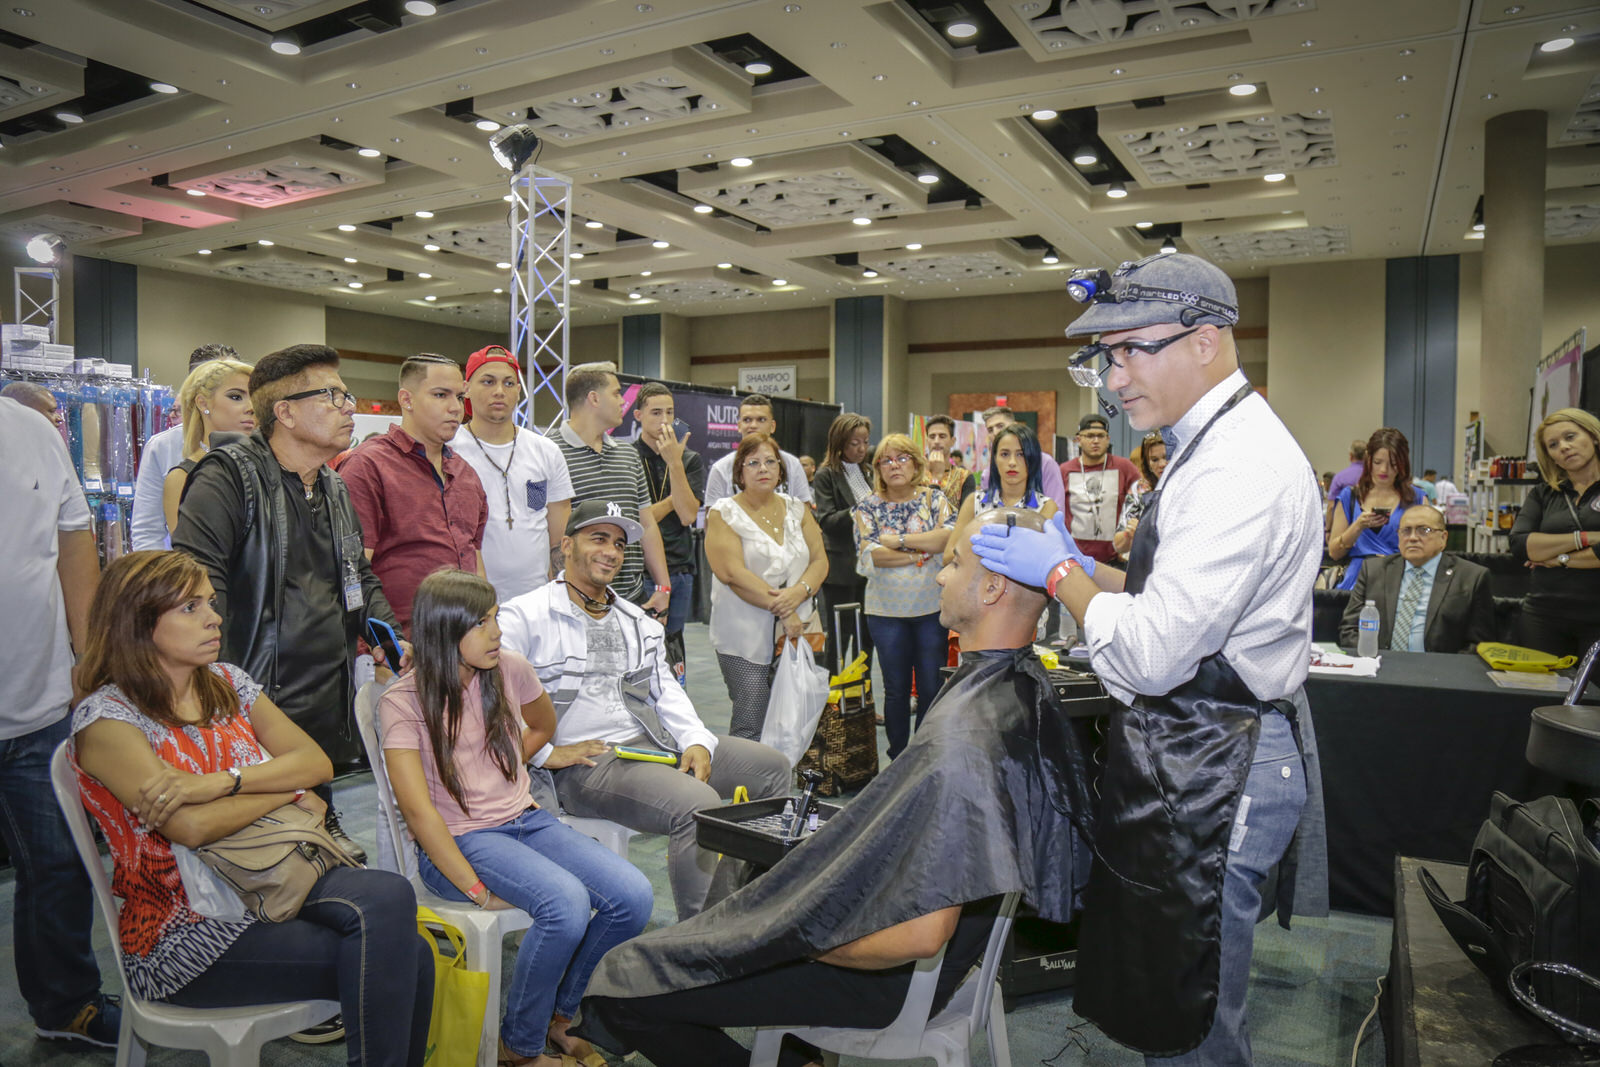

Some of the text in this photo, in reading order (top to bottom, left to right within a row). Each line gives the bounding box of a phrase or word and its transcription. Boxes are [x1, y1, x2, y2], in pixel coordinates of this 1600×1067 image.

[746, 373, 790, 383] SHAMPOO
[757, 385, 779, 393] AREA
[707, 404, 739, 424] NUTR
[606, 501, 622, 517] NY
[1044, 959, 1076, 970] SALLYMA
